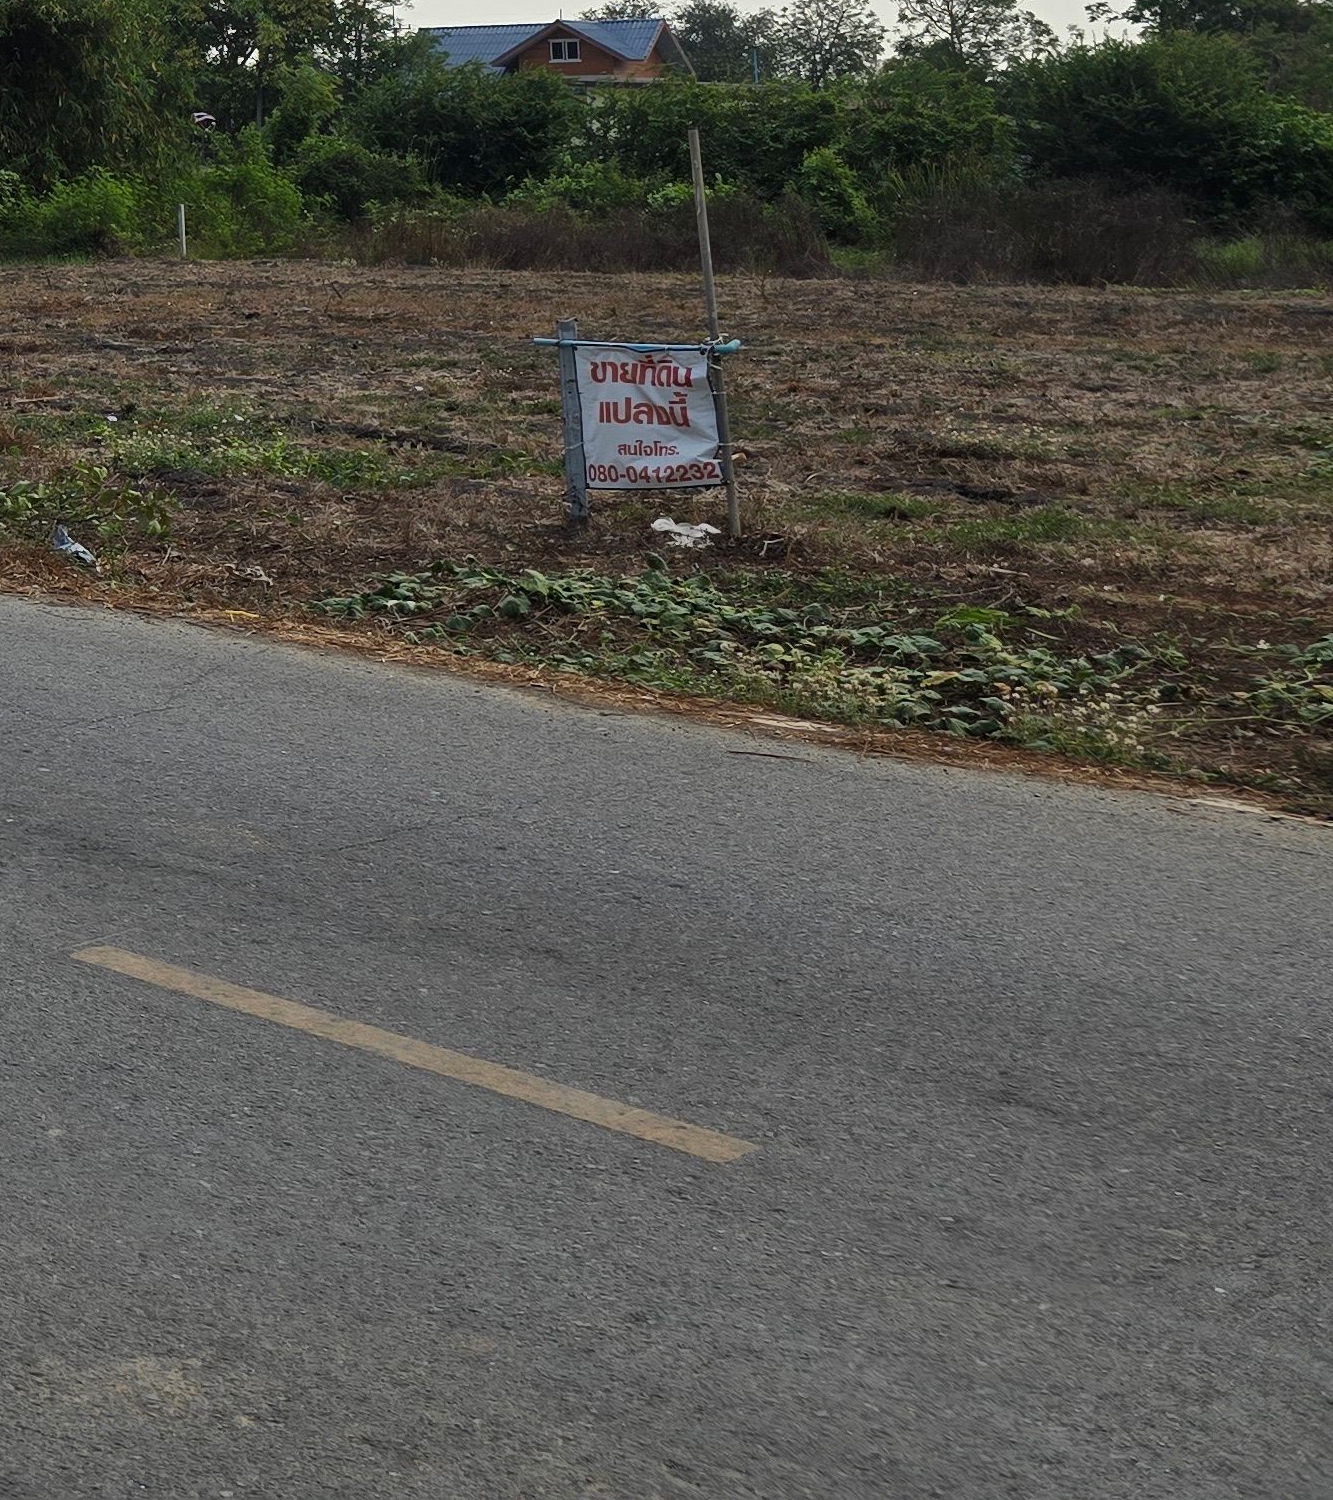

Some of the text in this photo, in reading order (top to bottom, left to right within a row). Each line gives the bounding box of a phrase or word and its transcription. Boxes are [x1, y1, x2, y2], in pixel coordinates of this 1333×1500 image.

[589, 354, 694, 388] ขายที่ดิน
[599, 391, 691, 428] แปลงนี้
[617, 439, 680, 457] สนใจโทร.
[588, 461, 721, 484] 080-0412232
